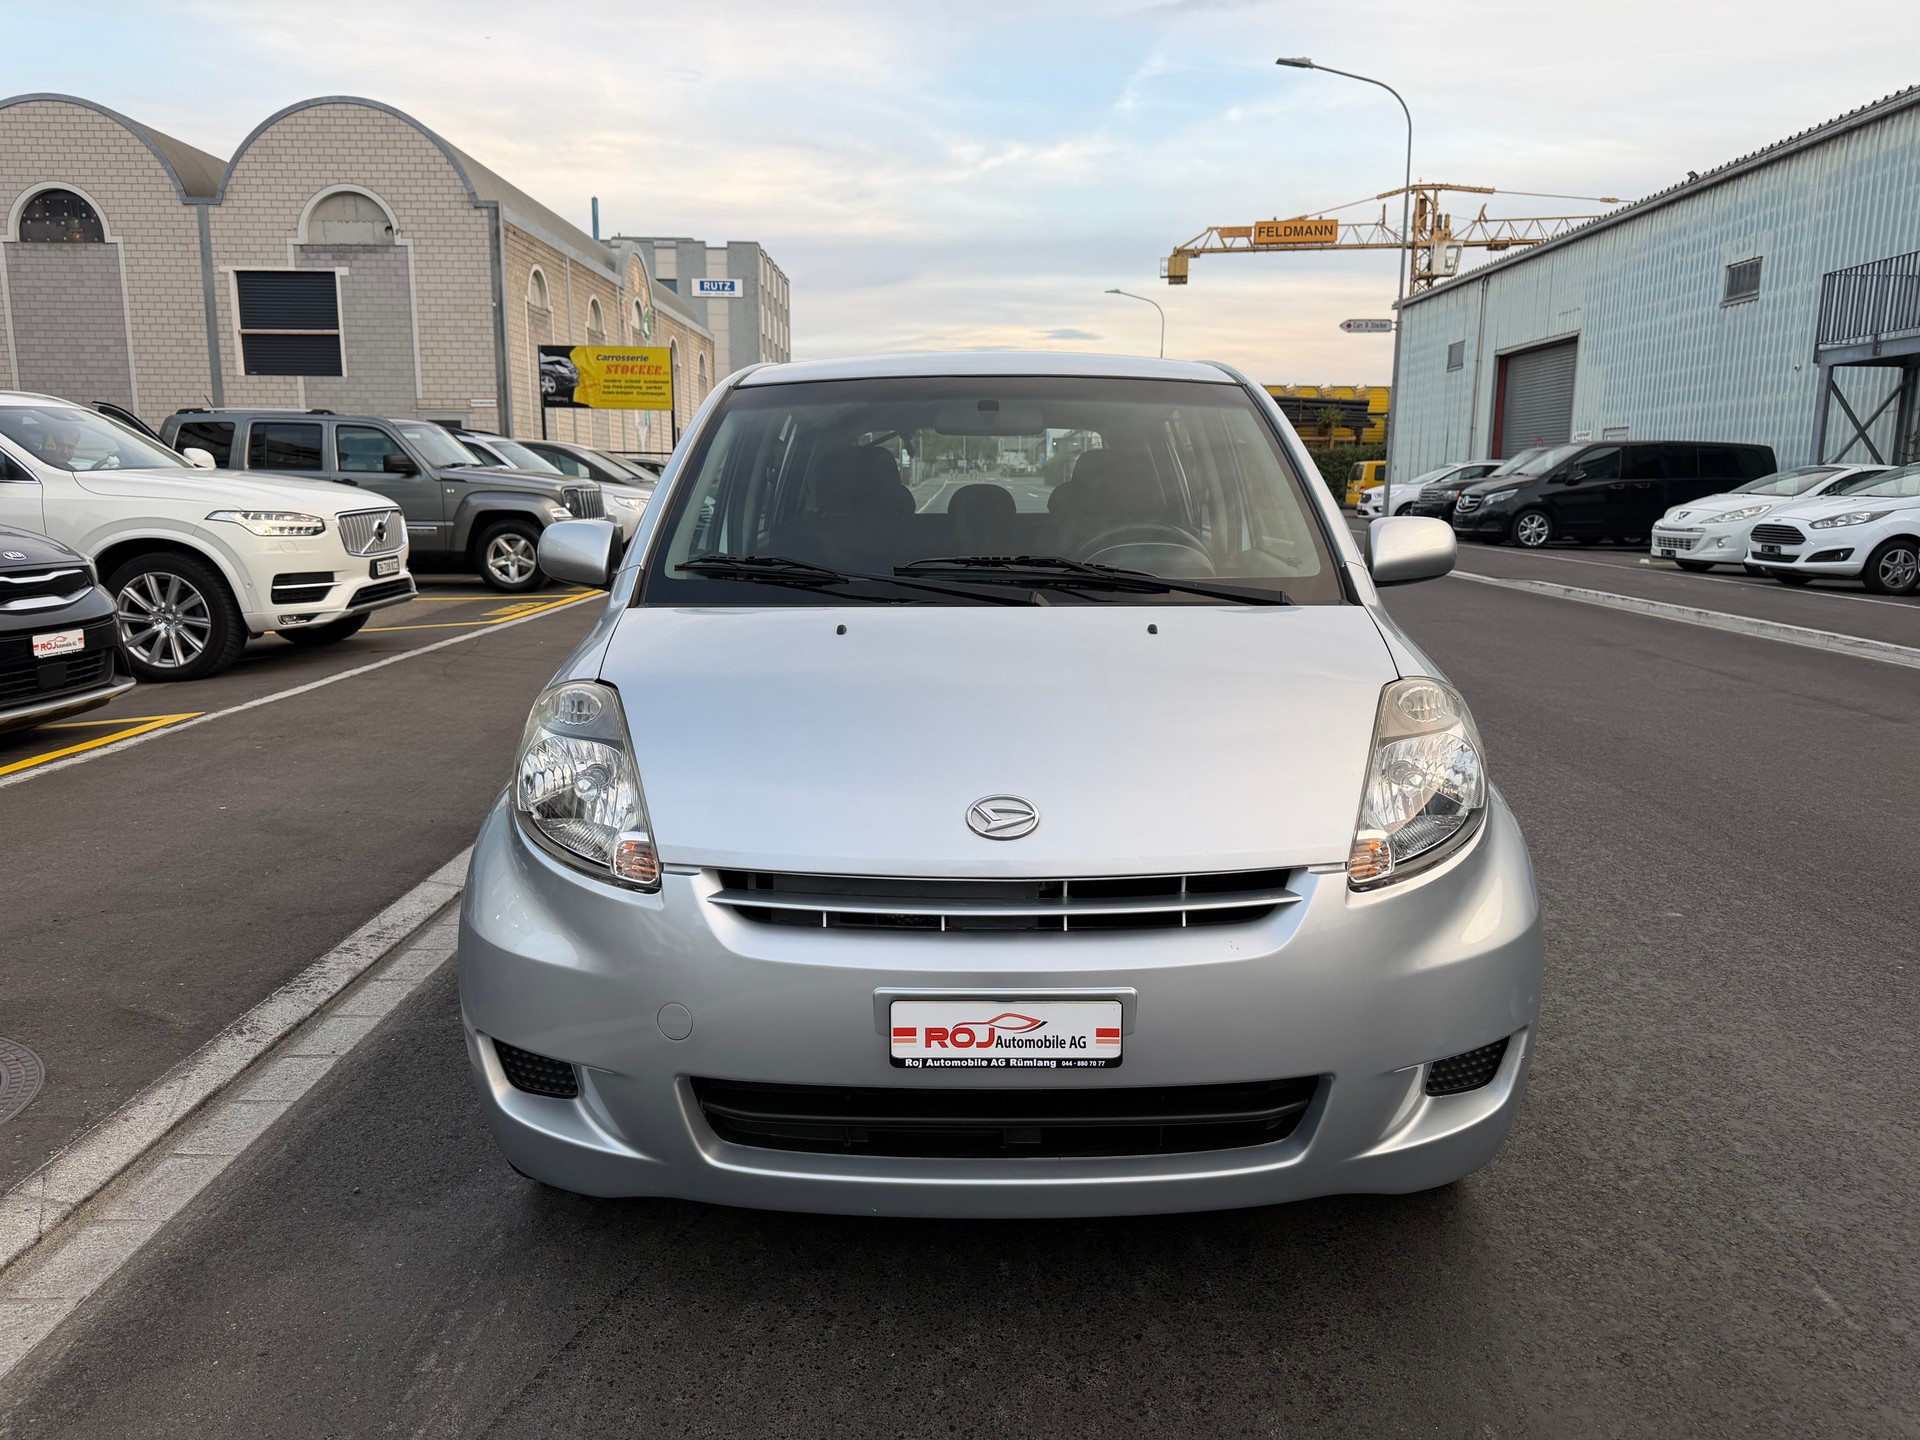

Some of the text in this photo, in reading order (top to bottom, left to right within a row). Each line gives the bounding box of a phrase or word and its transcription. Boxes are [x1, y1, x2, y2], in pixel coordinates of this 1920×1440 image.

[1258, 225, 1333, 237] FELDMANN
[703, 281, 731, 290] RUTZ
[596, 354, 649, 362] Carrosserie
[605, 364, 663, 375] STOCKER
[40, 641, 57, 651] ROJ
[925, 1027, 1087, 1049] ROJ Automobile AG
[905, 1058, 923, 1068] Roj
[926, 1058, 988, 1067] Automobile
[990, 1058, 1006, 1067] AG
[1009, 1058, 1057, 1068] Rümlang
